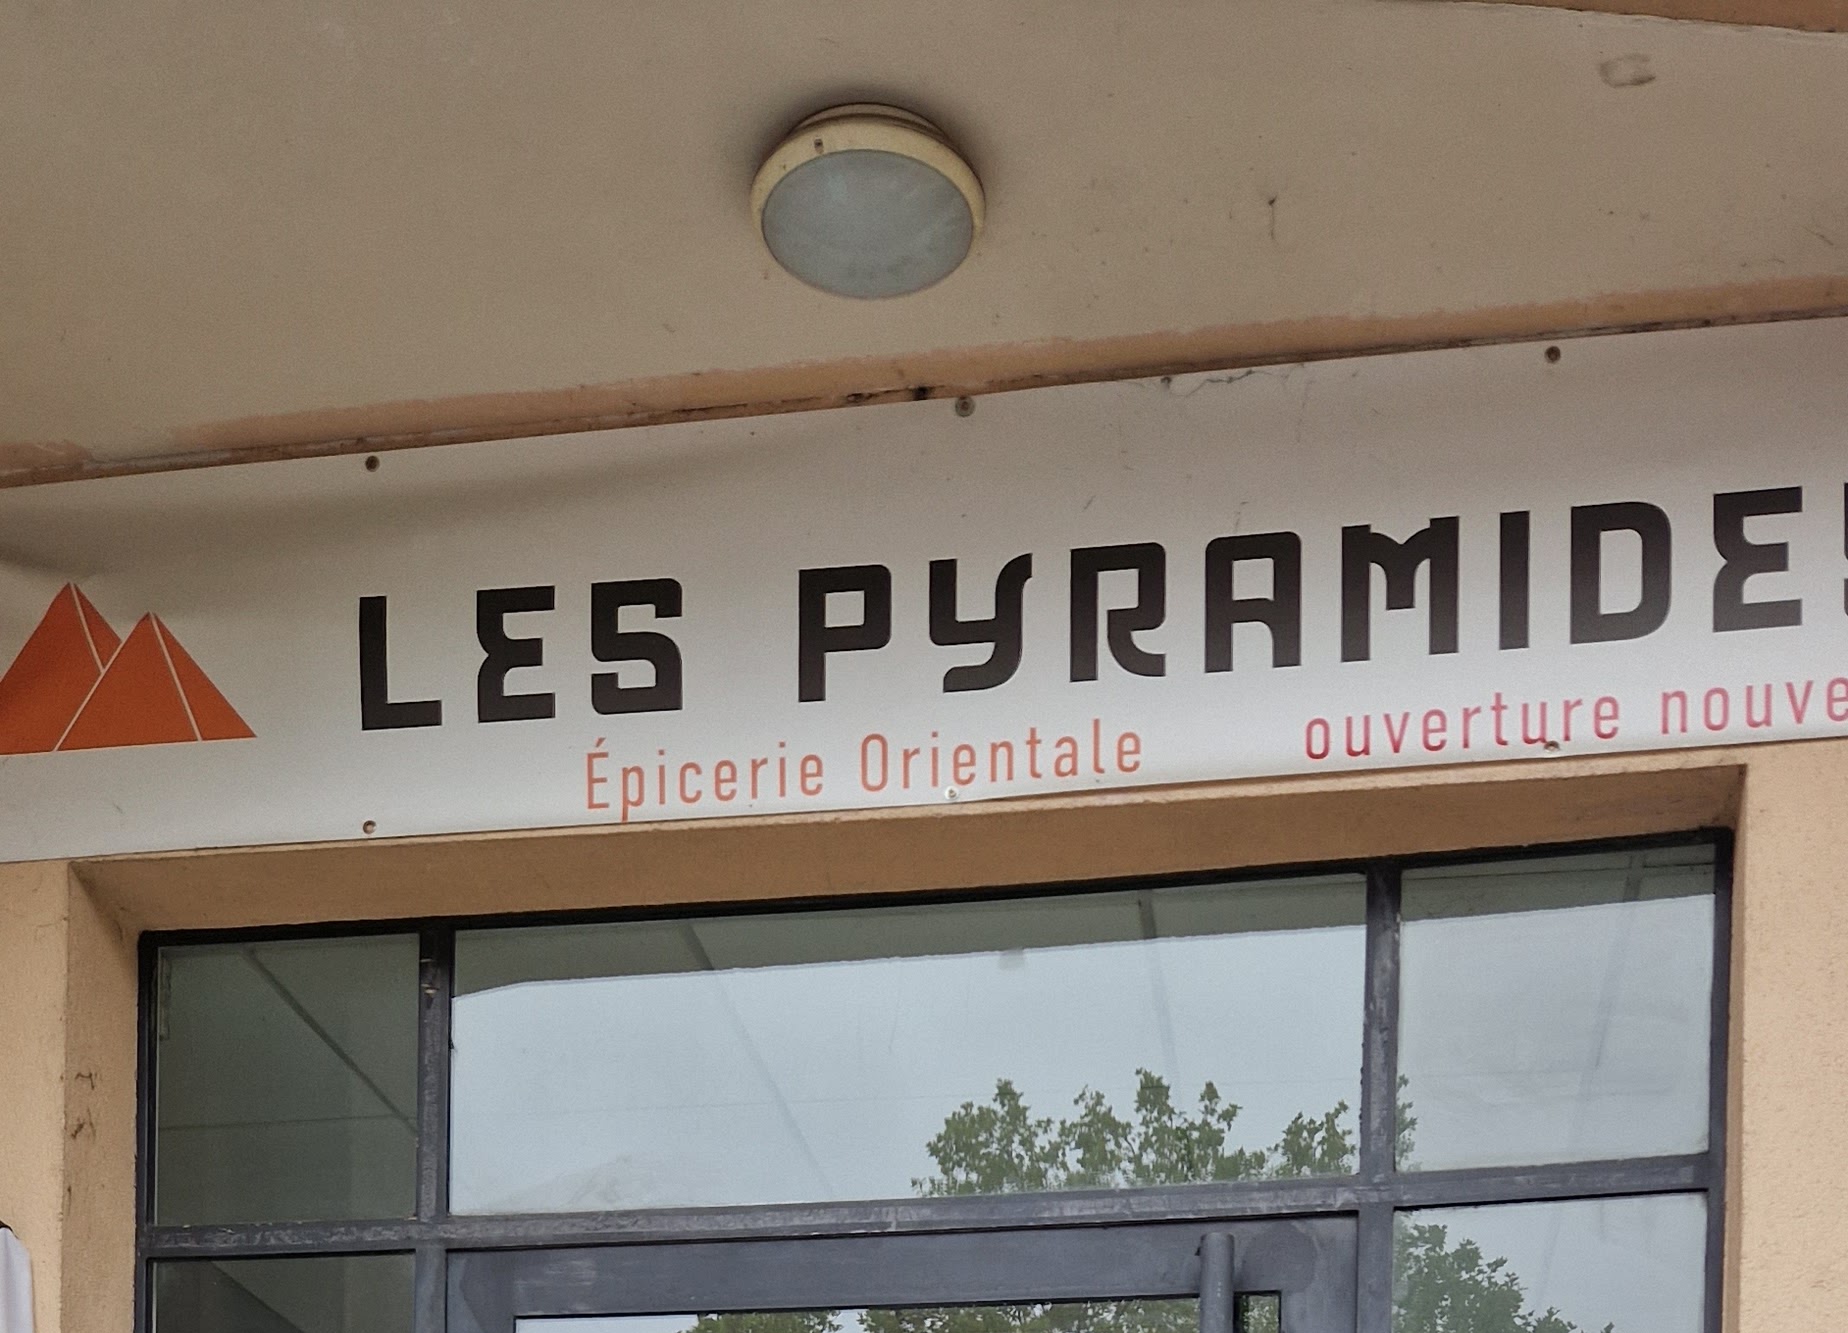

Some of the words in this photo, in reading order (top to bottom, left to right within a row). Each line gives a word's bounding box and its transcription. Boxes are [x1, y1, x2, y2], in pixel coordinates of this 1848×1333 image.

[359, 577, 683, 731] LES
[798, 481, 1848, 703] PYRAMIDE
[585, 737, 825, 824] Épicerie
[860, 718, 1142, 793] Orientale
[1304, 691, 1621, 761] ouverture
